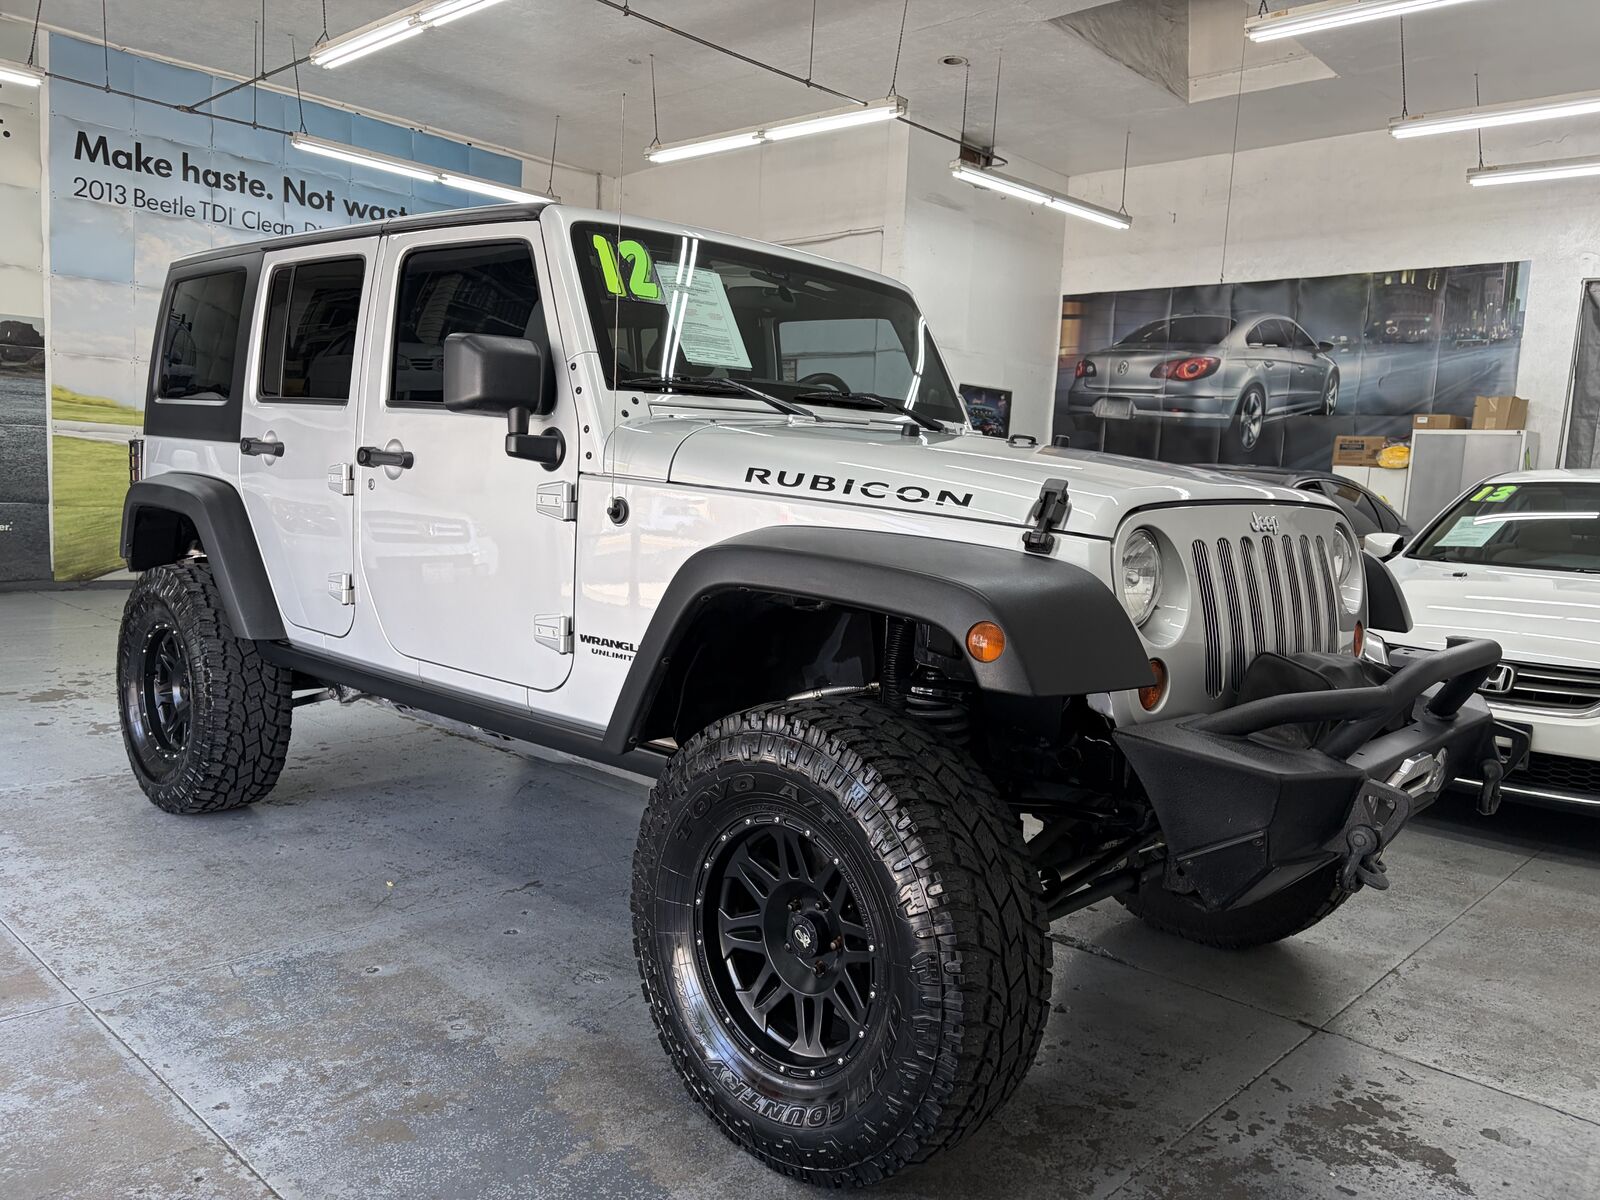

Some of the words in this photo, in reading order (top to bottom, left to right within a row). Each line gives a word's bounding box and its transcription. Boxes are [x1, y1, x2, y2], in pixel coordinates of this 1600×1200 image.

[74, 131, 173, 178] Make
[182, 152, 273, 200] haste.
[283, 176, 335, 212] Not
[73, 177, 127, 205] 2013
[134, 188, 196, 217] Beetle
[241, 211, 294, 234] Clean
[593, 234, 660, 300] 12
[745, 467, 974, 507] RUBICON
[1470, 485, 1518, 502] 13
[1250, 511, 1279, 535] Jeep
[579, 634, 640, 653] WRANGL
[675, 773, 756, 840] TOYO
[705, 1059, 848, 1128] COUNTRY
